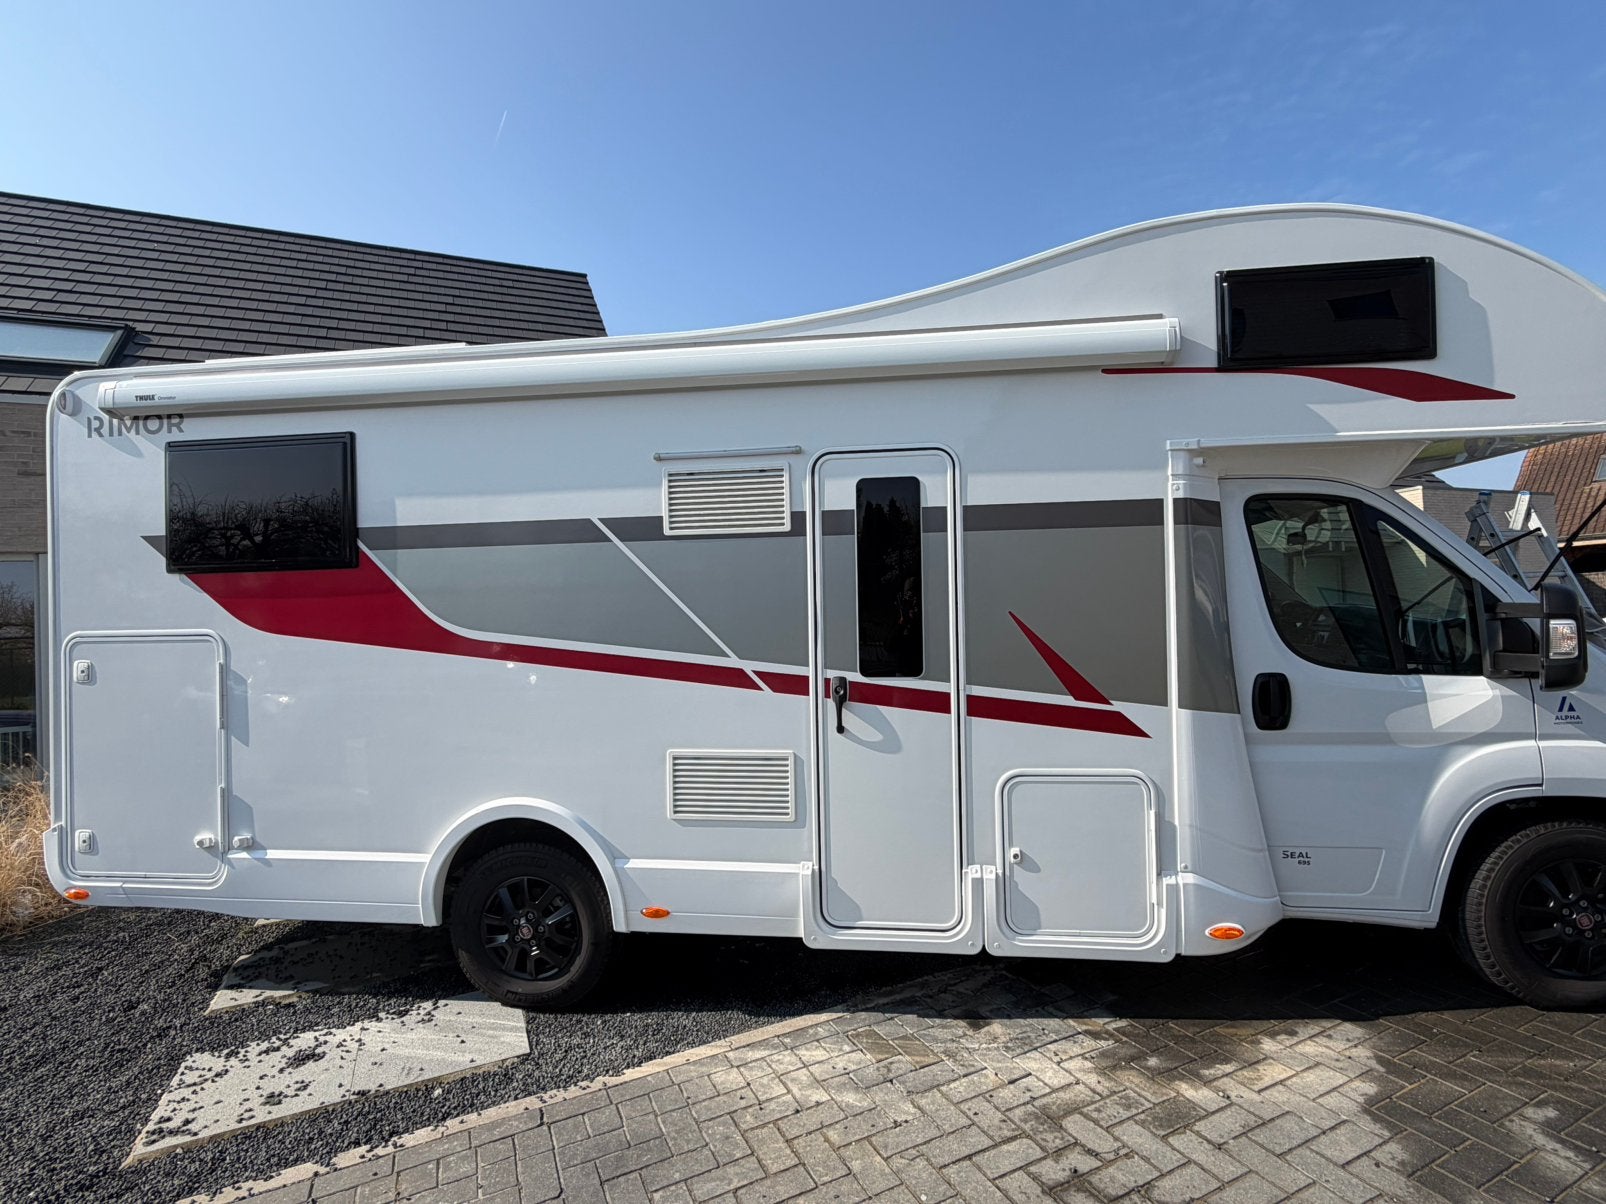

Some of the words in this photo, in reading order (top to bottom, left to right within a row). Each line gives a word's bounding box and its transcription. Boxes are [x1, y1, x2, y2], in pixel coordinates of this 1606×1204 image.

[134, 394, 156, 402] THULE
[87, 413, 185, 438] RIMOR
[1282, 850, 1311, 859] SEAL
